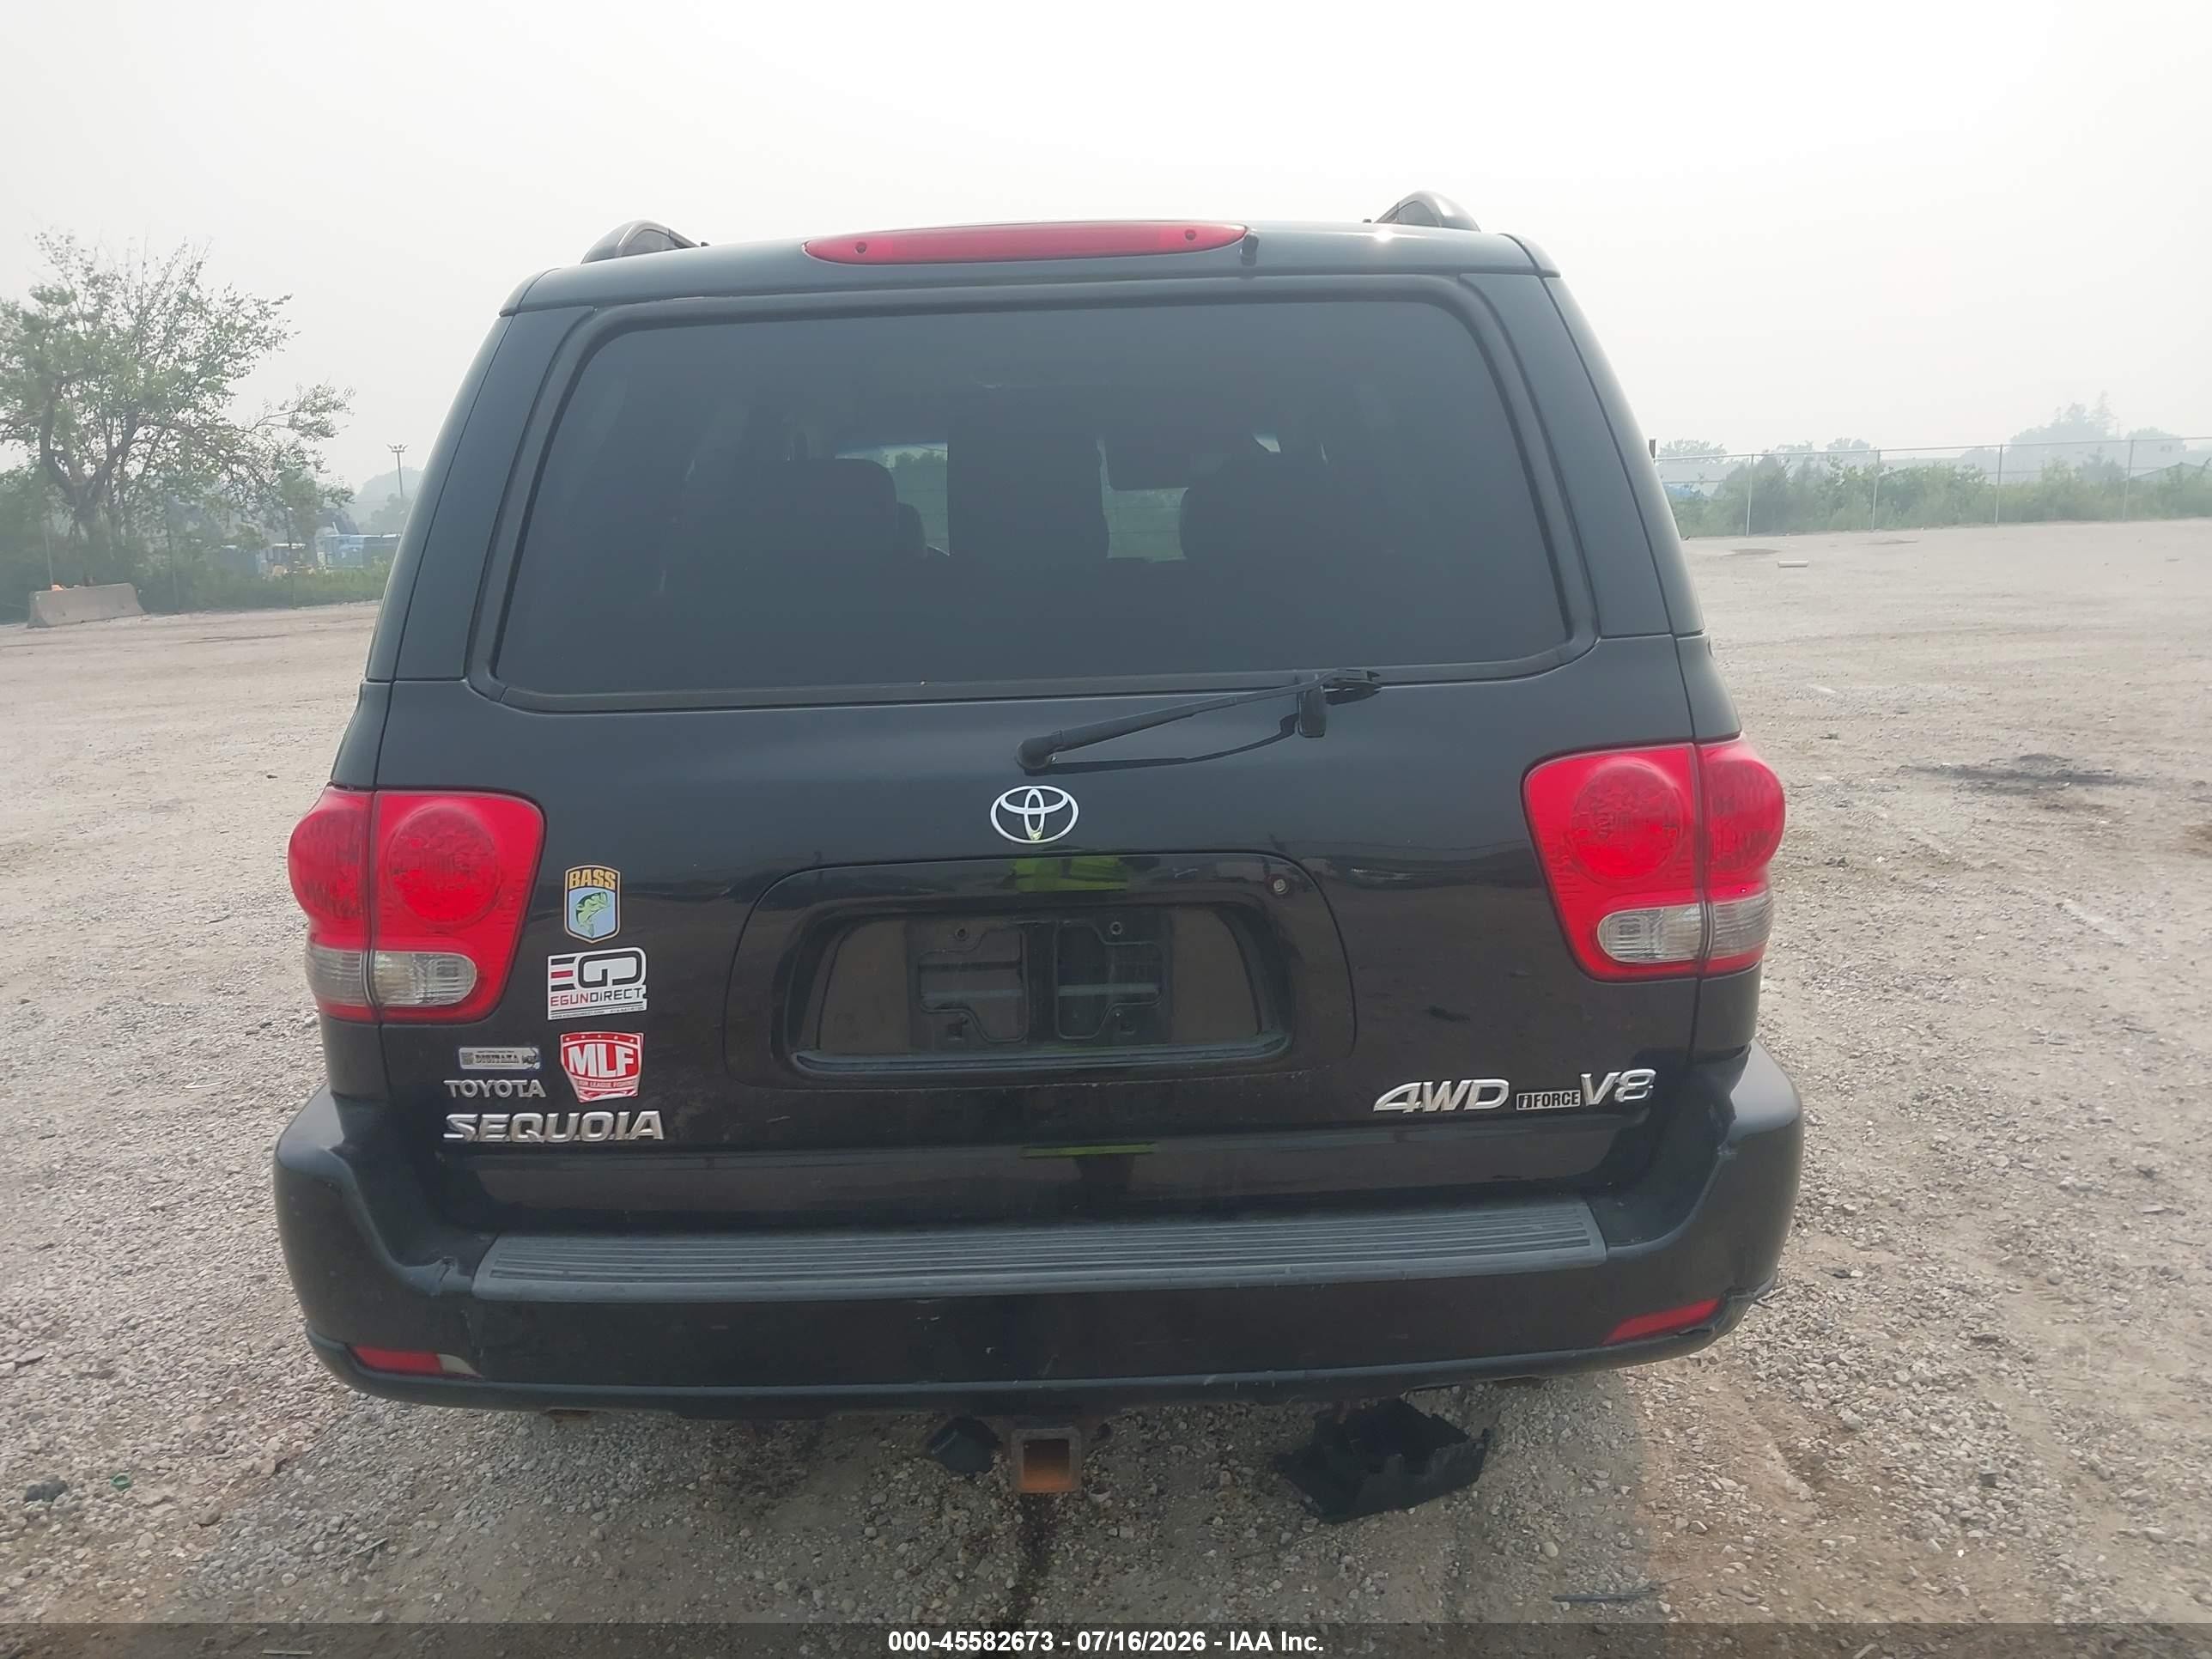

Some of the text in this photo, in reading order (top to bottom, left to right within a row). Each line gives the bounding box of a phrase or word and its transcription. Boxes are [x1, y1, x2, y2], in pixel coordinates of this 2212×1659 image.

[568, 868, 616, 890] BASS
[550, 988, 642, 1006] EGUNDIRECT
[568, 1043, 635, 1078] MLF
[443, 1079, 546, 1098] TOYOTA
[1374, 1079, 1510, 1113] 4WD
[1580, 1068, 1656, 1107] V8
[443, 1110, 665, 1143] SEQUOIA
